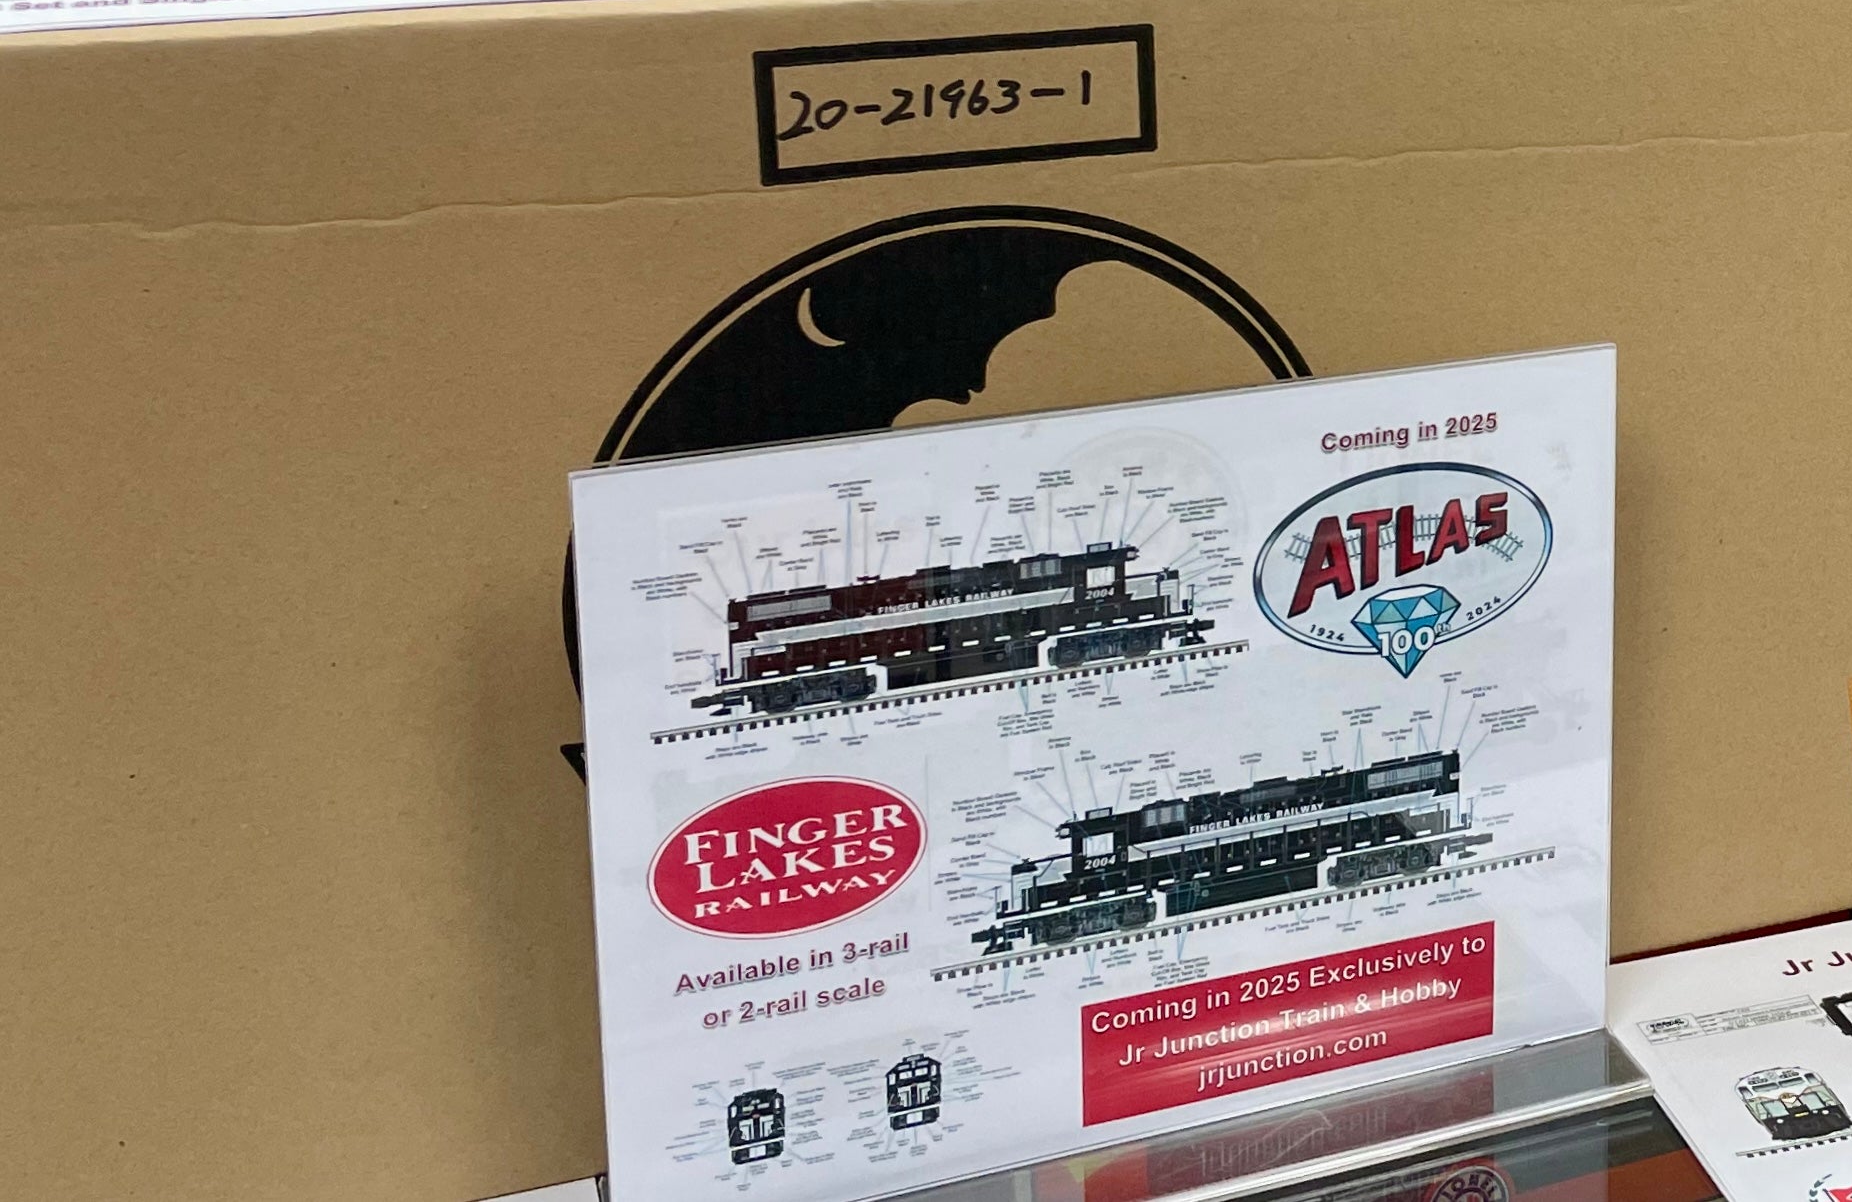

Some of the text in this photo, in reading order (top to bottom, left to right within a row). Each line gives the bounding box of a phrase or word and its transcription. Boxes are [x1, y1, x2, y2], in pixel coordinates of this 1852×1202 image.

[776, 70, 1092, 141] 20-21963-1
[1321, 412, 1498, 453] Coming in 2025
[1287, 492, 1508, 618] ATLAS
[1309, 596, 1501, 643] 1924 2024
[684, 804, 908, 865] FINGER
[1190, 802, 1324, 834] FINGER RAILWAY
[695, 835, 896, 894] LAKES
[1084, 855, 1117, 871] 2004
[694, 870, 896, 918] RAILWAY
[675, 932, 910, 995] Available in 3-rail
[1091, 935, 1486, 1034] Coming in 2025 Exclusively to
[1782, 957, 1815, 977] Jr
[703, 977, 886, 1028] or 2-rail scale
[1119, 977, 1463, 1067] Jr Junction Train & Hobby
[1197, 1030, 1388, 1092] jrjunction.com
